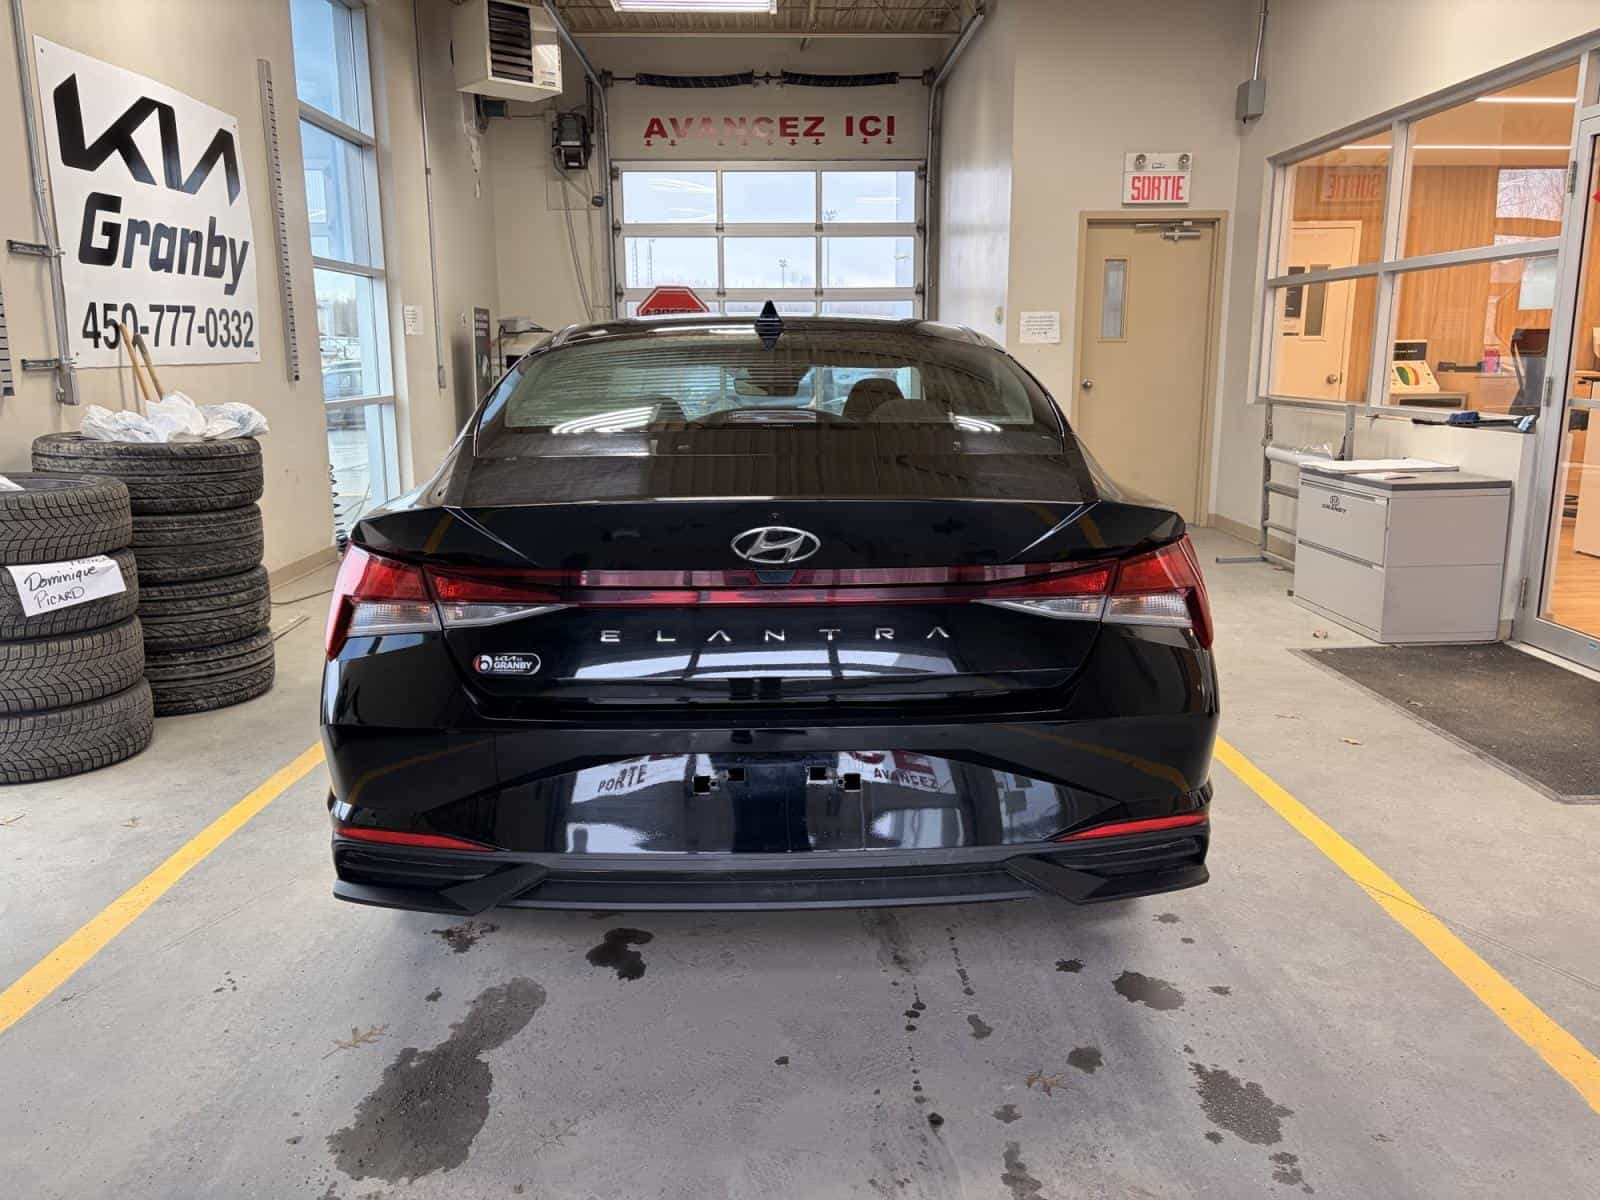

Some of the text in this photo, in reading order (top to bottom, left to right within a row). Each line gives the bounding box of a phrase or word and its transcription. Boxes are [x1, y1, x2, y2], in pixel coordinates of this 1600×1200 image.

[643, 116, 825, 139] AVANCEZ
[1131, 175, 1185, 201] SORTIE
[78, 191, 249, 296] Granby
[82, 301, 254, 350] 450-777-0332
[24, 566, 98, 592] Dominique
[600, 626, 950, 643] ELANTRA
[597, 763, 649, 793] PORTE
[873, 767, 938, 789] AVANCEZ
